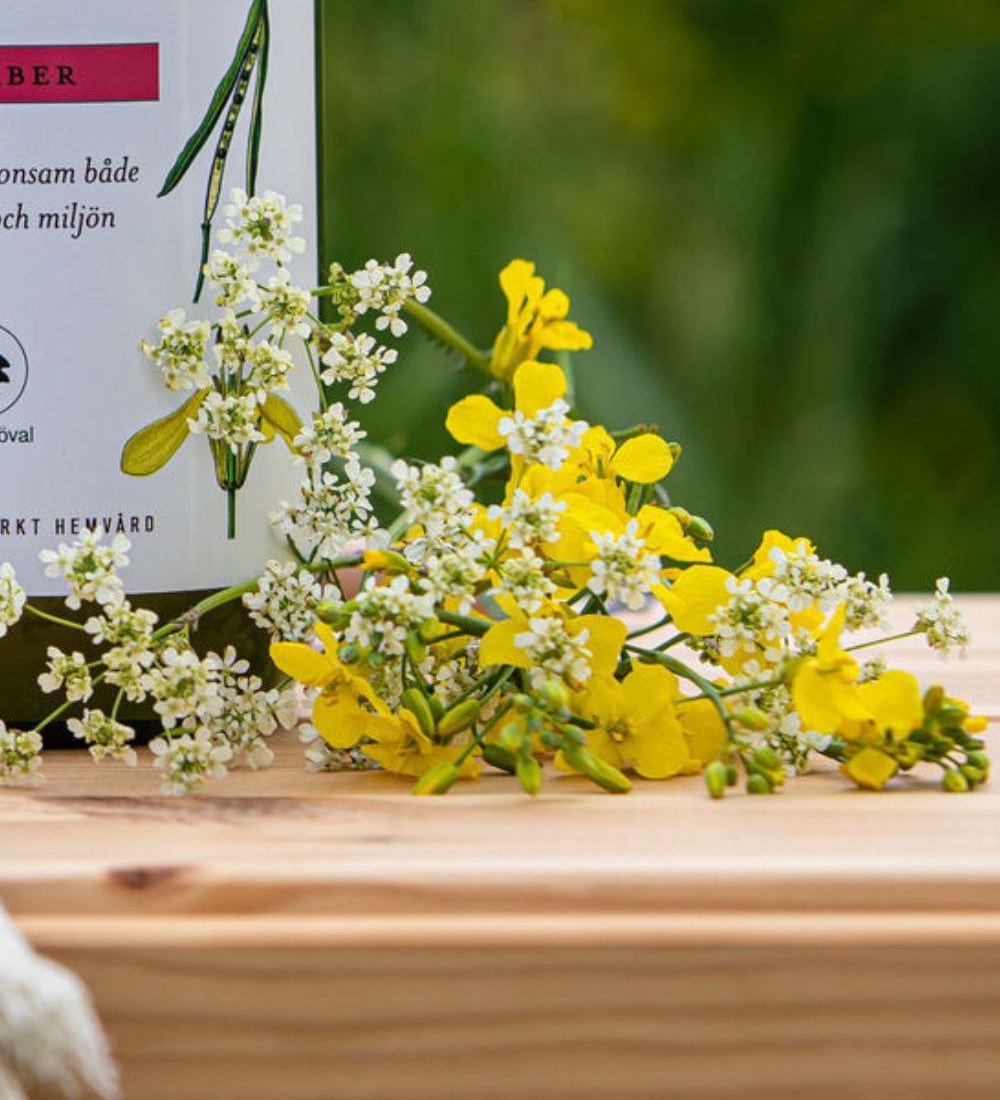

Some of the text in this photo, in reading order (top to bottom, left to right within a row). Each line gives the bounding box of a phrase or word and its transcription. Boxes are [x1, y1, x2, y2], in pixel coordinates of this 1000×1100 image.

[84, 155, 140, 185] både
[38, 201, 115, 239] miljön
[55, 512, 155, 535] HEMVÅRD
